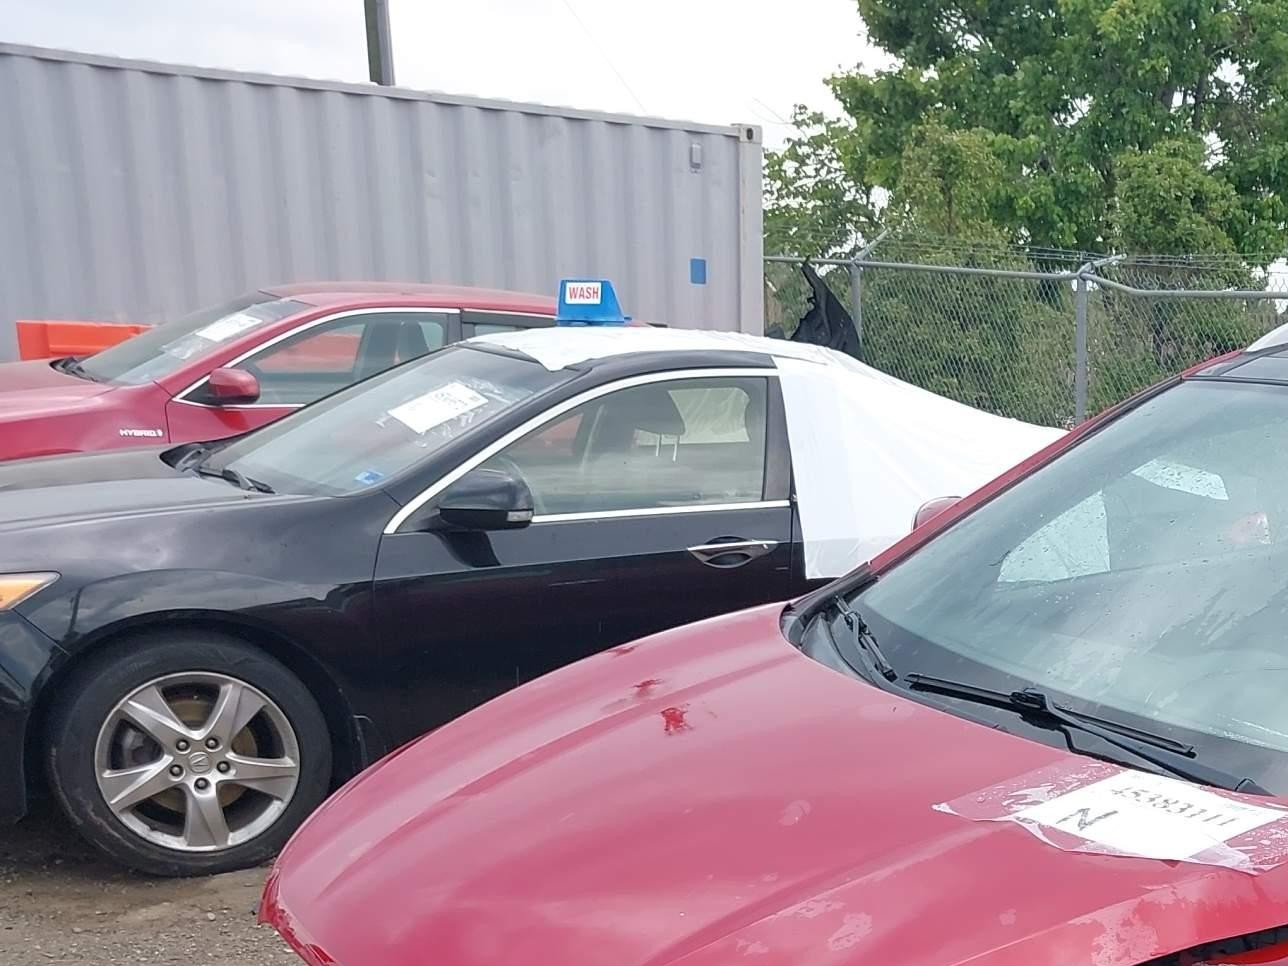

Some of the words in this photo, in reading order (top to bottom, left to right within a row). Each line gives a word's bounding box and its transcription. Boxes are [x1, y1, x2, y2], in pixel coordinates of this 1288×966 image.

[568, 286, 599, 300] WASH
[119, 428, 156, 437] HYBRID
[1110, 786, 1238, 827] 45383111
[1055, 807, 1119, 831] N
